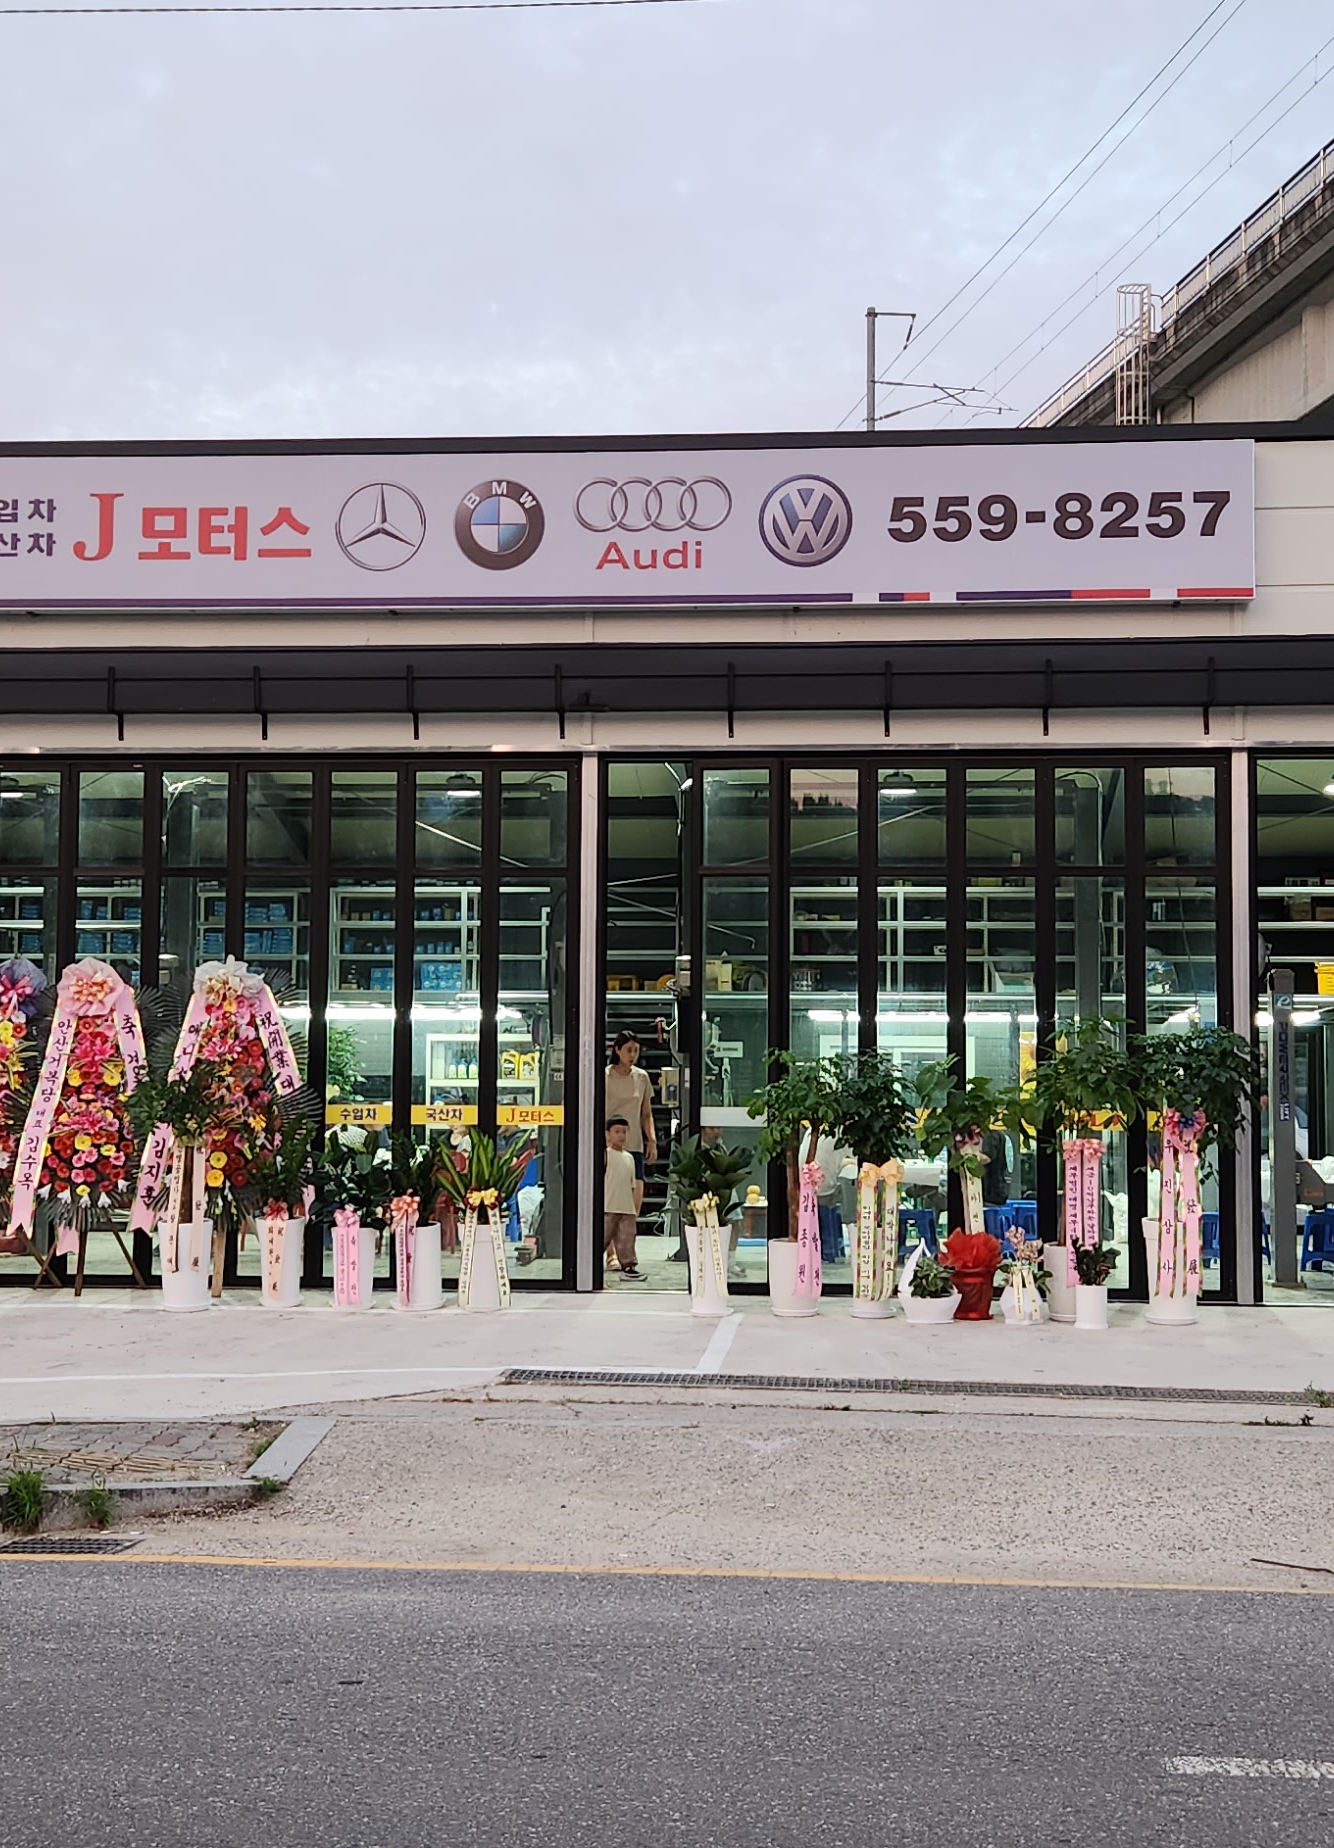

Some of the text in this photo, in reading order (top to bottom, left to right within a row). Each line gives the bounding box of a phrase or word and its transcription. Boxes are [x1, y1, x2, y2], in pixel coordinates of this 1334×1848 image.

[463, 481, 537, 511] BMW
[887, 490, 1232, 542] 559-8257
[73, 492, 312, 561] J 모터스
[595, 541, 703, 570] Audi
[18, 1018, 73, 1191] 안산거북당 대표 김수옥
[339, 1107, 555, 1123] 수입차 국산차 J 모터스
[140, 1137, 168, 1207] 김지훈
[1161, 1138, 1174, 1275] 우진상사
